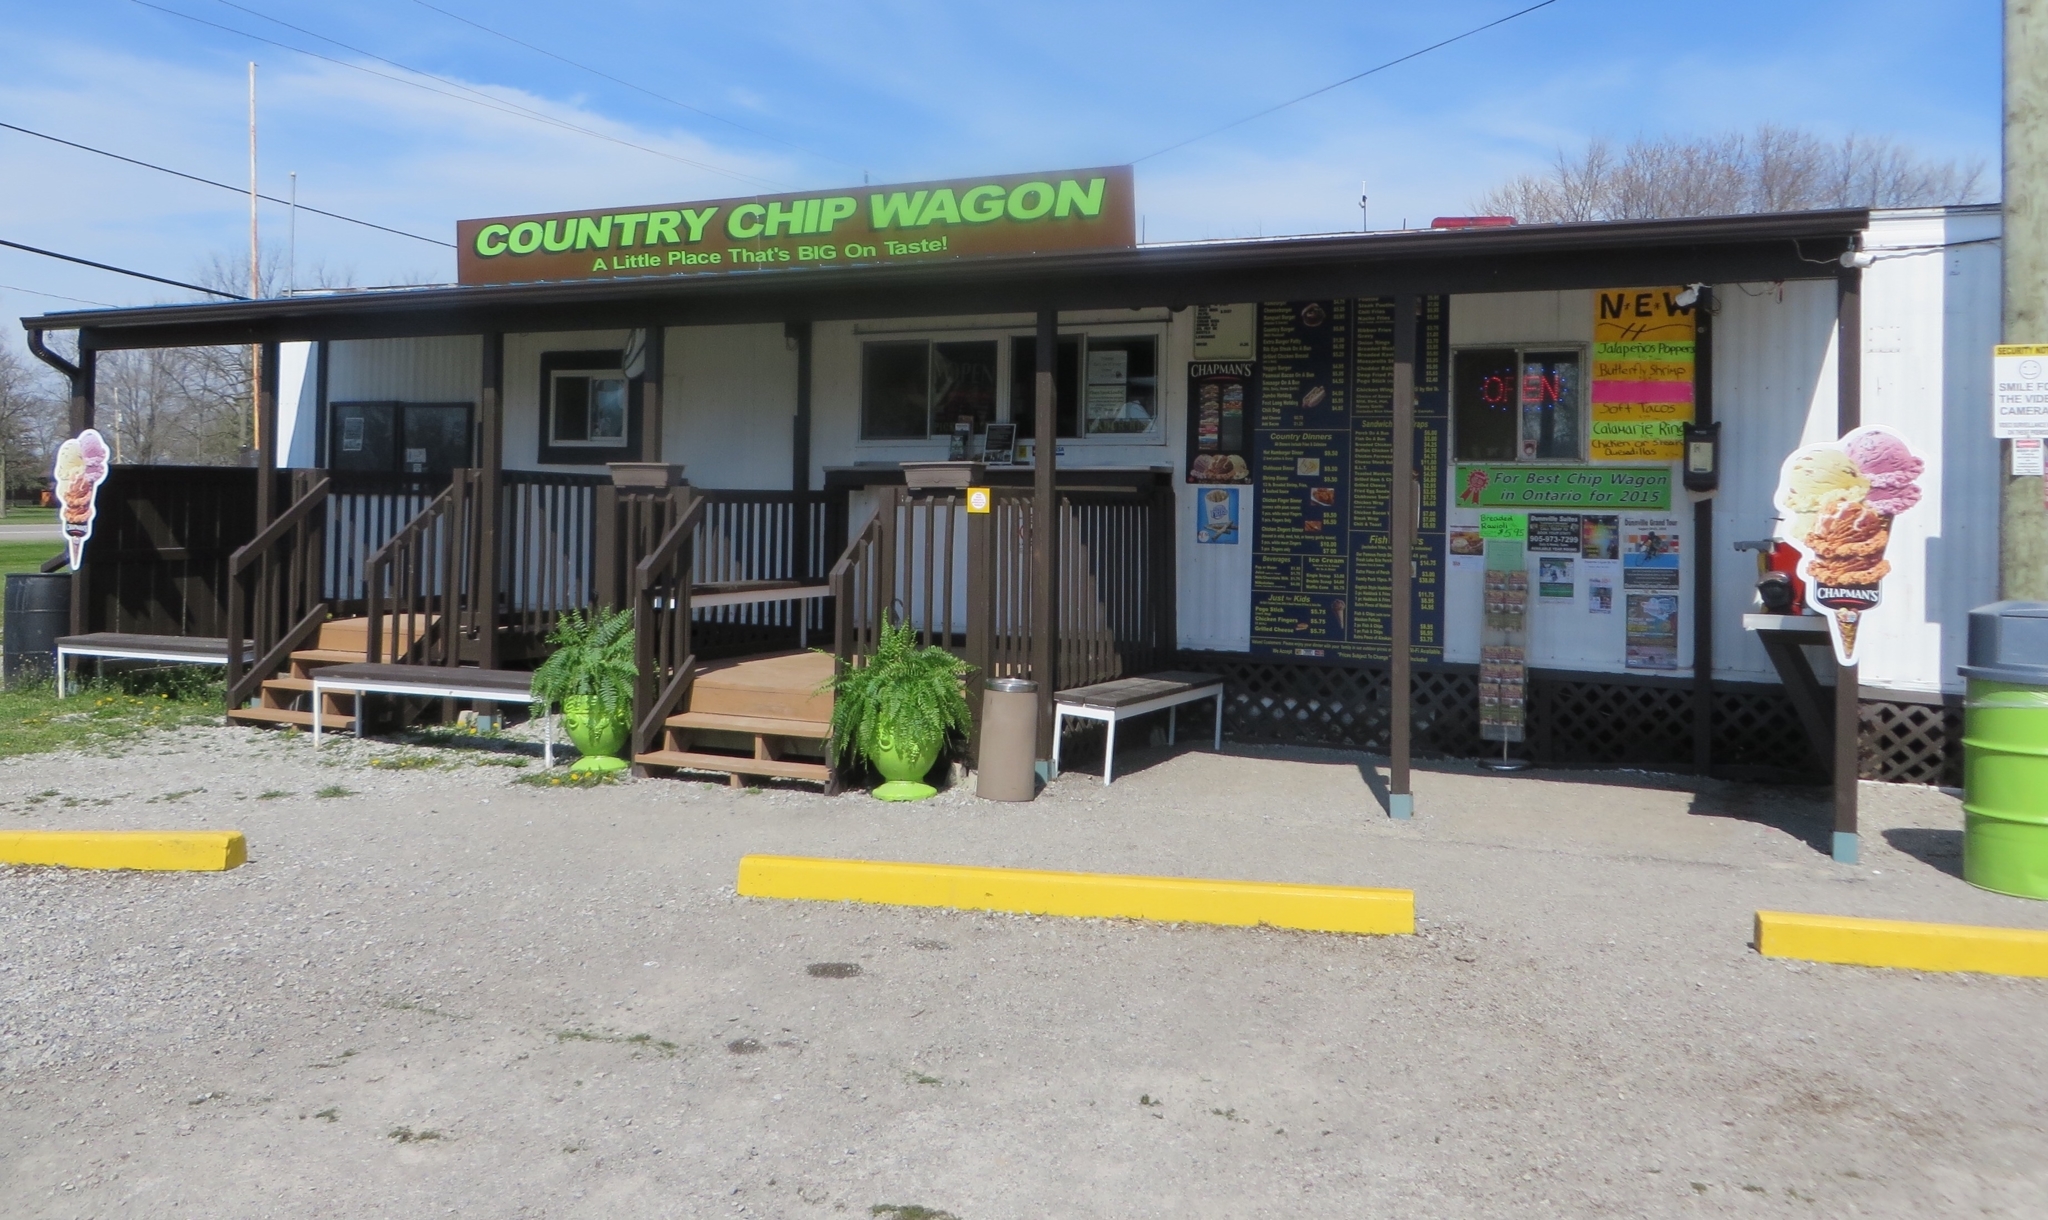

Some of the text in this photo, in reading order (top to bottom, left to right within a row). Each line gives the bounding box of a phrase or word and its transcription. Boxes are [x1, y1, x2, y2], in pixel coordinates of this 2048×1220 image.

[476, 178, 1105, 256] COUNTRY CHIP WAGON
[592, 237, 947, 271] A Little Place That's BIG On Taste!
[1998, 346, 2048, 355] SECURITY NOT
[1191, 364, 1252, 377] CHAPMAN'S
[1484, 375, 1560, 402] OPEN
[1999, 383, 2048, 391] SMILE FO
[1999, 395, 2048, 403] THE VIDE
[2000, 407, 2048, 415] CAMERA
[1362, 420, 1393, 428] Sandwich
[1659, 421, 1684, 436] Ring
[1270, 433, 1300, 441] Country
[1494, 473, 1667, 487] For Best Chip Wagon
[1500, 490, 1659, 501] in Ontario for 2015
[1369, 535, 1388, 544] Fish
[1293, 595, 1311, 603] Kids
[1817, 587, 1879, 602] CHAPMAN'S
